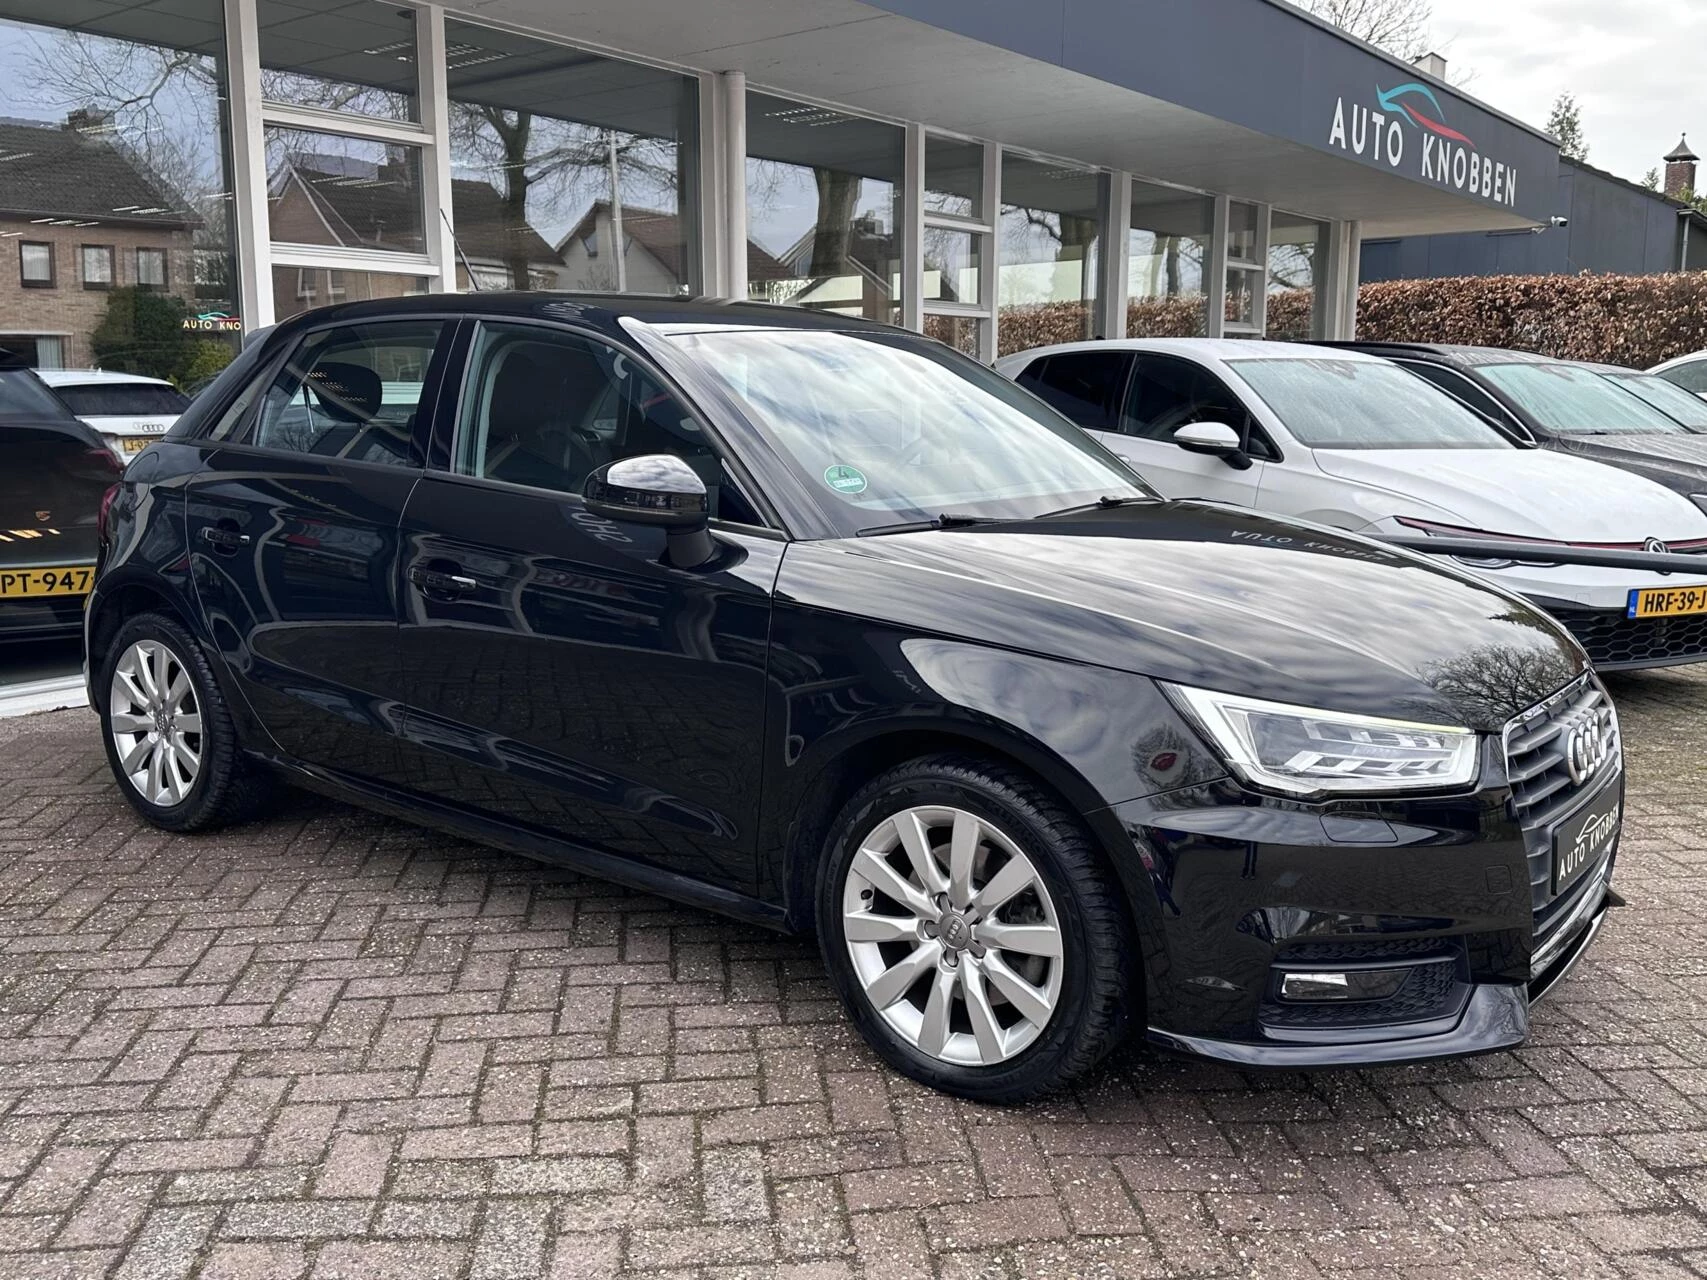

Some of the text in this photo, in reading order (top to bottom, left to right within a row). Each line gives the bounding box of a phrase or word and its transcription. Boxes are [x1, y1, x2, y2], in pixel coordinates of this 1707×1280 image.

[1329, 97, 1517, 207] AUTO KNOBBEN
[183, 320, 212, 330] AUTO
[1643, 590, 1707, 613] HRF-39-J
[1559, 842, 1585, 881] AUTO
